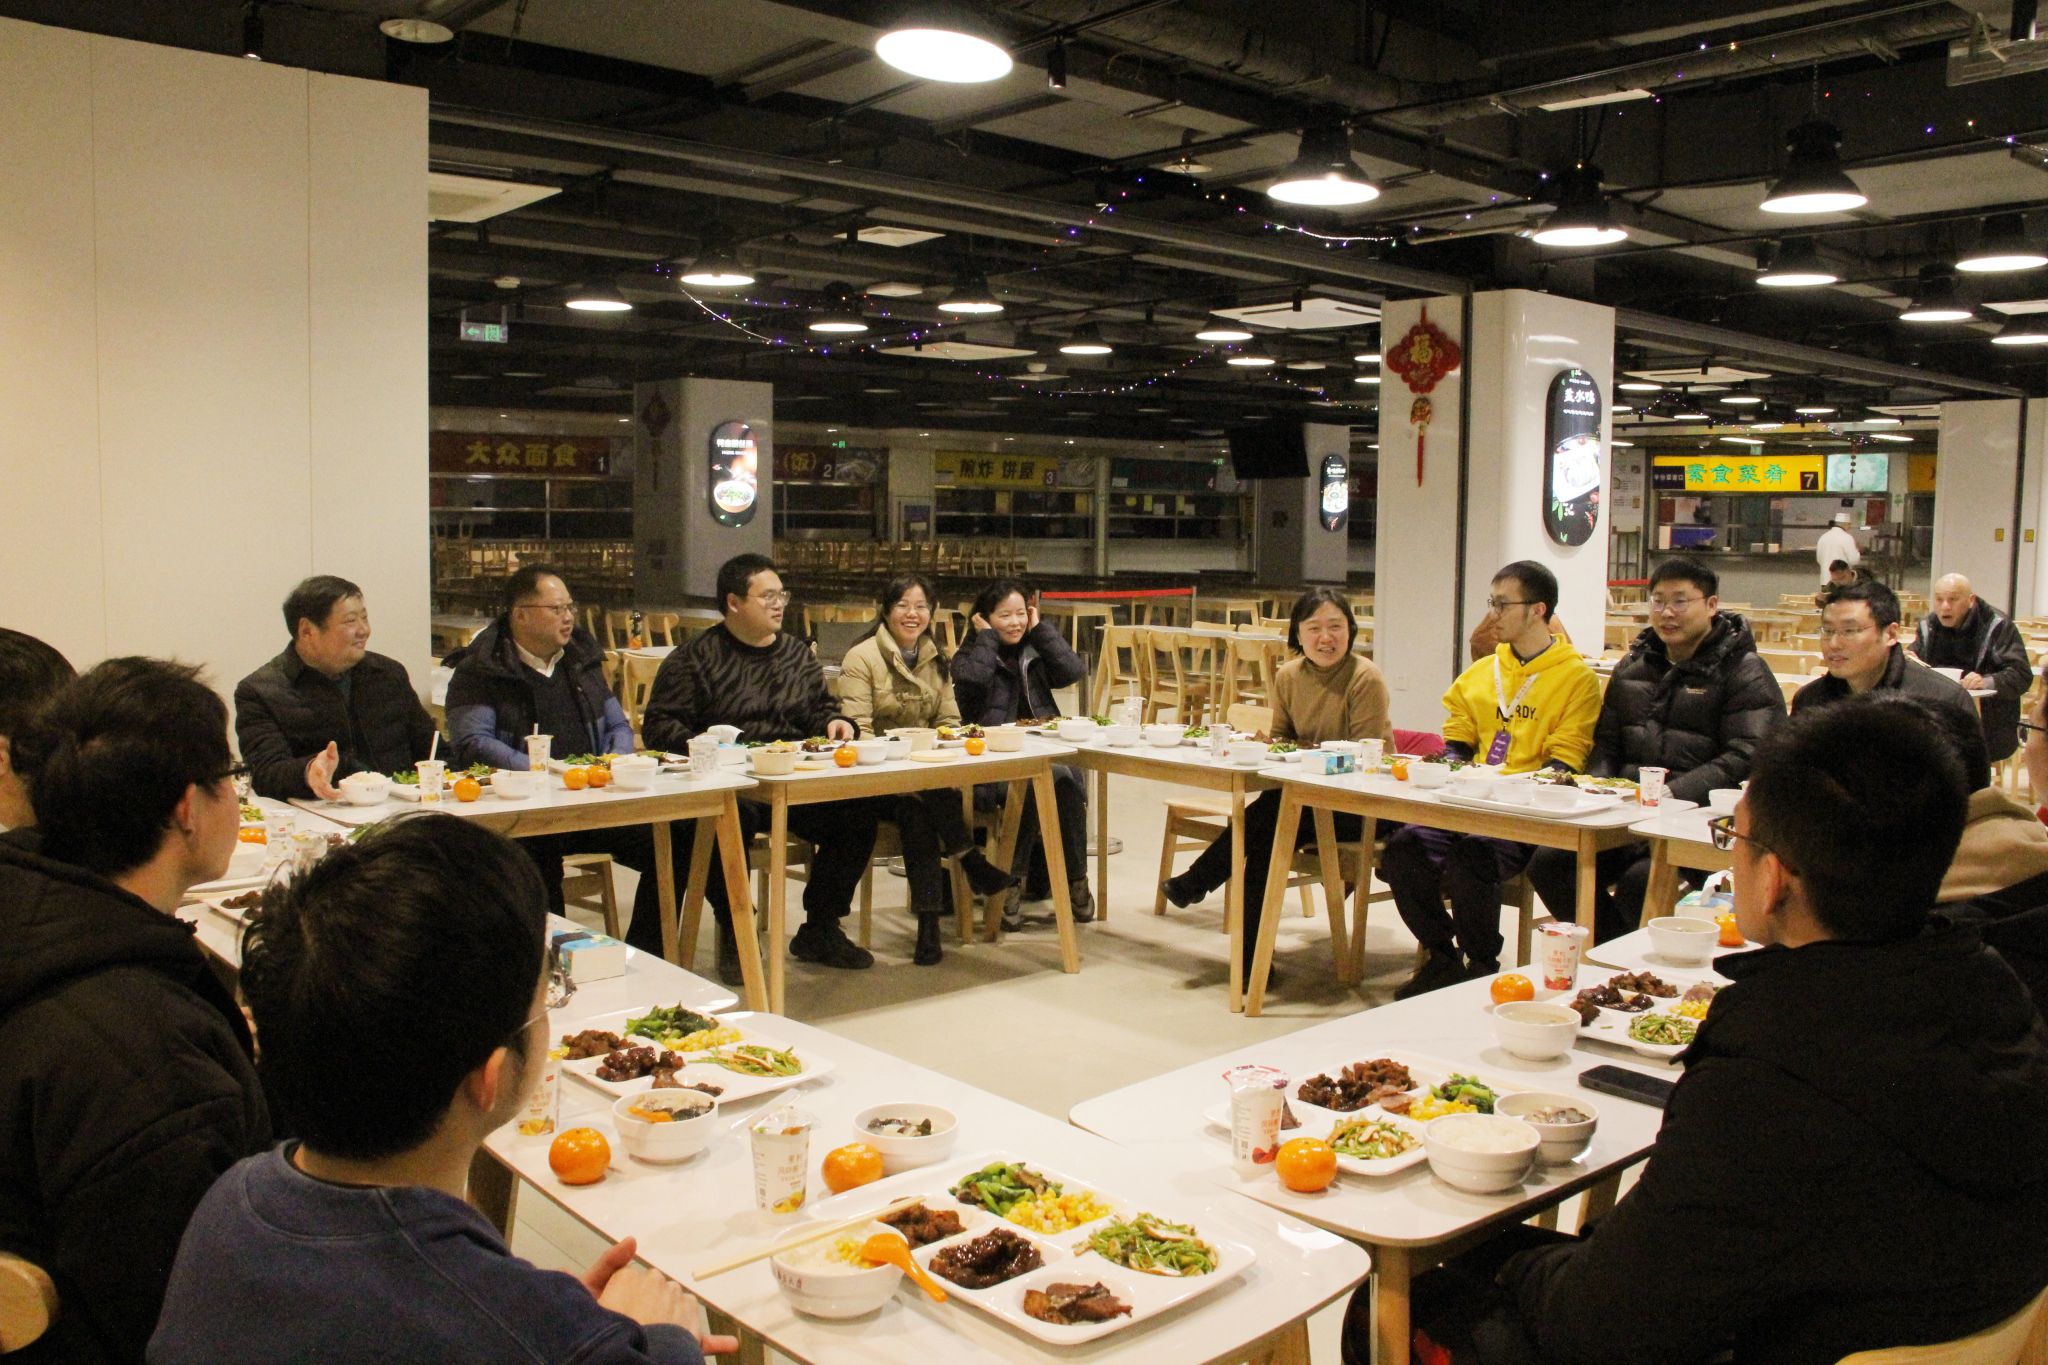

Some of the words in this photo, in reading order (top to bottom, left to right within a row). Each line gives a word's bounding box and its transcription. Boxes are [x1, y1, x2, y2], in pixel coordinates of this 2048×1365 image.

[465, 440, 578, 468] 大众面食
[597, 456, 605, 472] 1
[823, 463, 833, 478] 2
[1045, 471, 1054, 485] 3
[1685, 462, 1788, 485] 素食菜肴
[1803, 473, 1815, 489] 7
[1207, 477, 1214, 489] 4
[1496, 705, 1537, 720] NRDY
